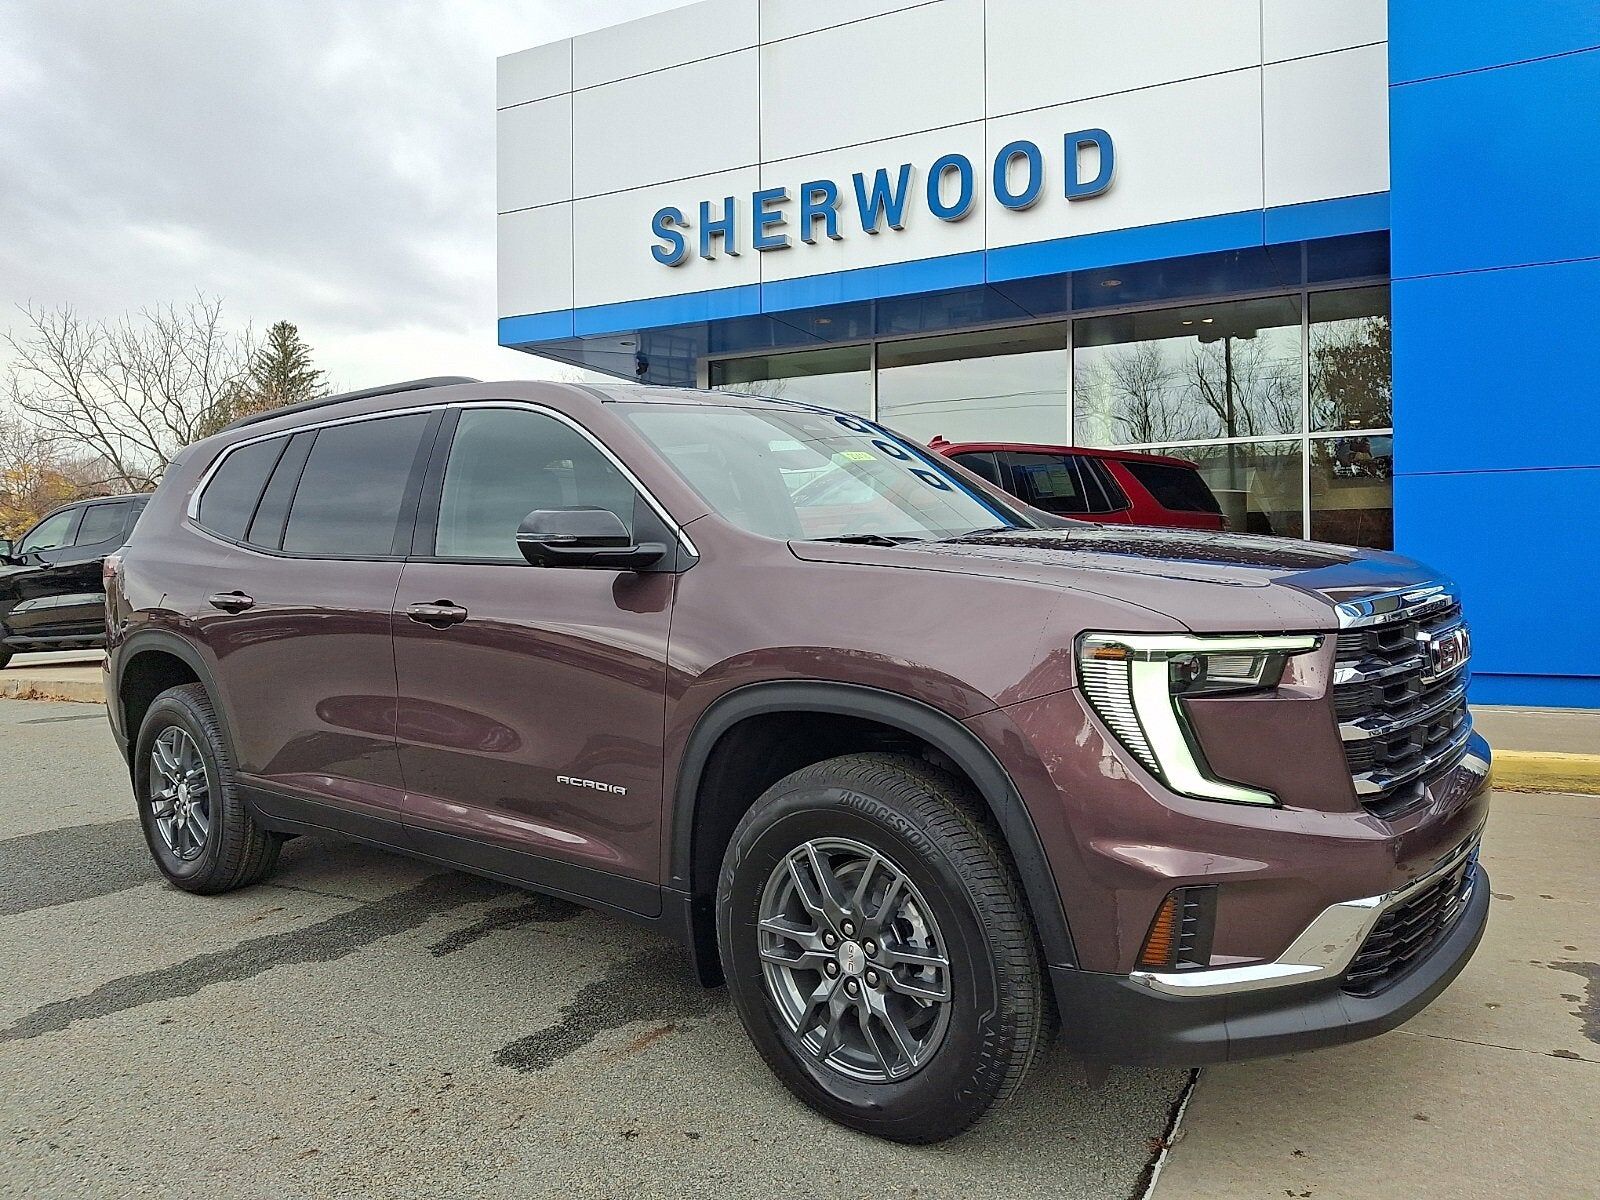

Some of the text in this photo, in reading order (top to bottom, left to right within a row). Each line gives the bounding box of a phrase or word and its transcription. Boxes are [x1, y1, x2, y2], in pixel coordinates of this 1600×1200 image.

[650, 128, 1118, 267] SHERWOOD
[1432, 629, 1471, 673] GM
[556, 775, 627, 795] ACADIA
[839, 790, 940, 864] BRIDGESTONE
[847, 944, 855, 971] GMC
